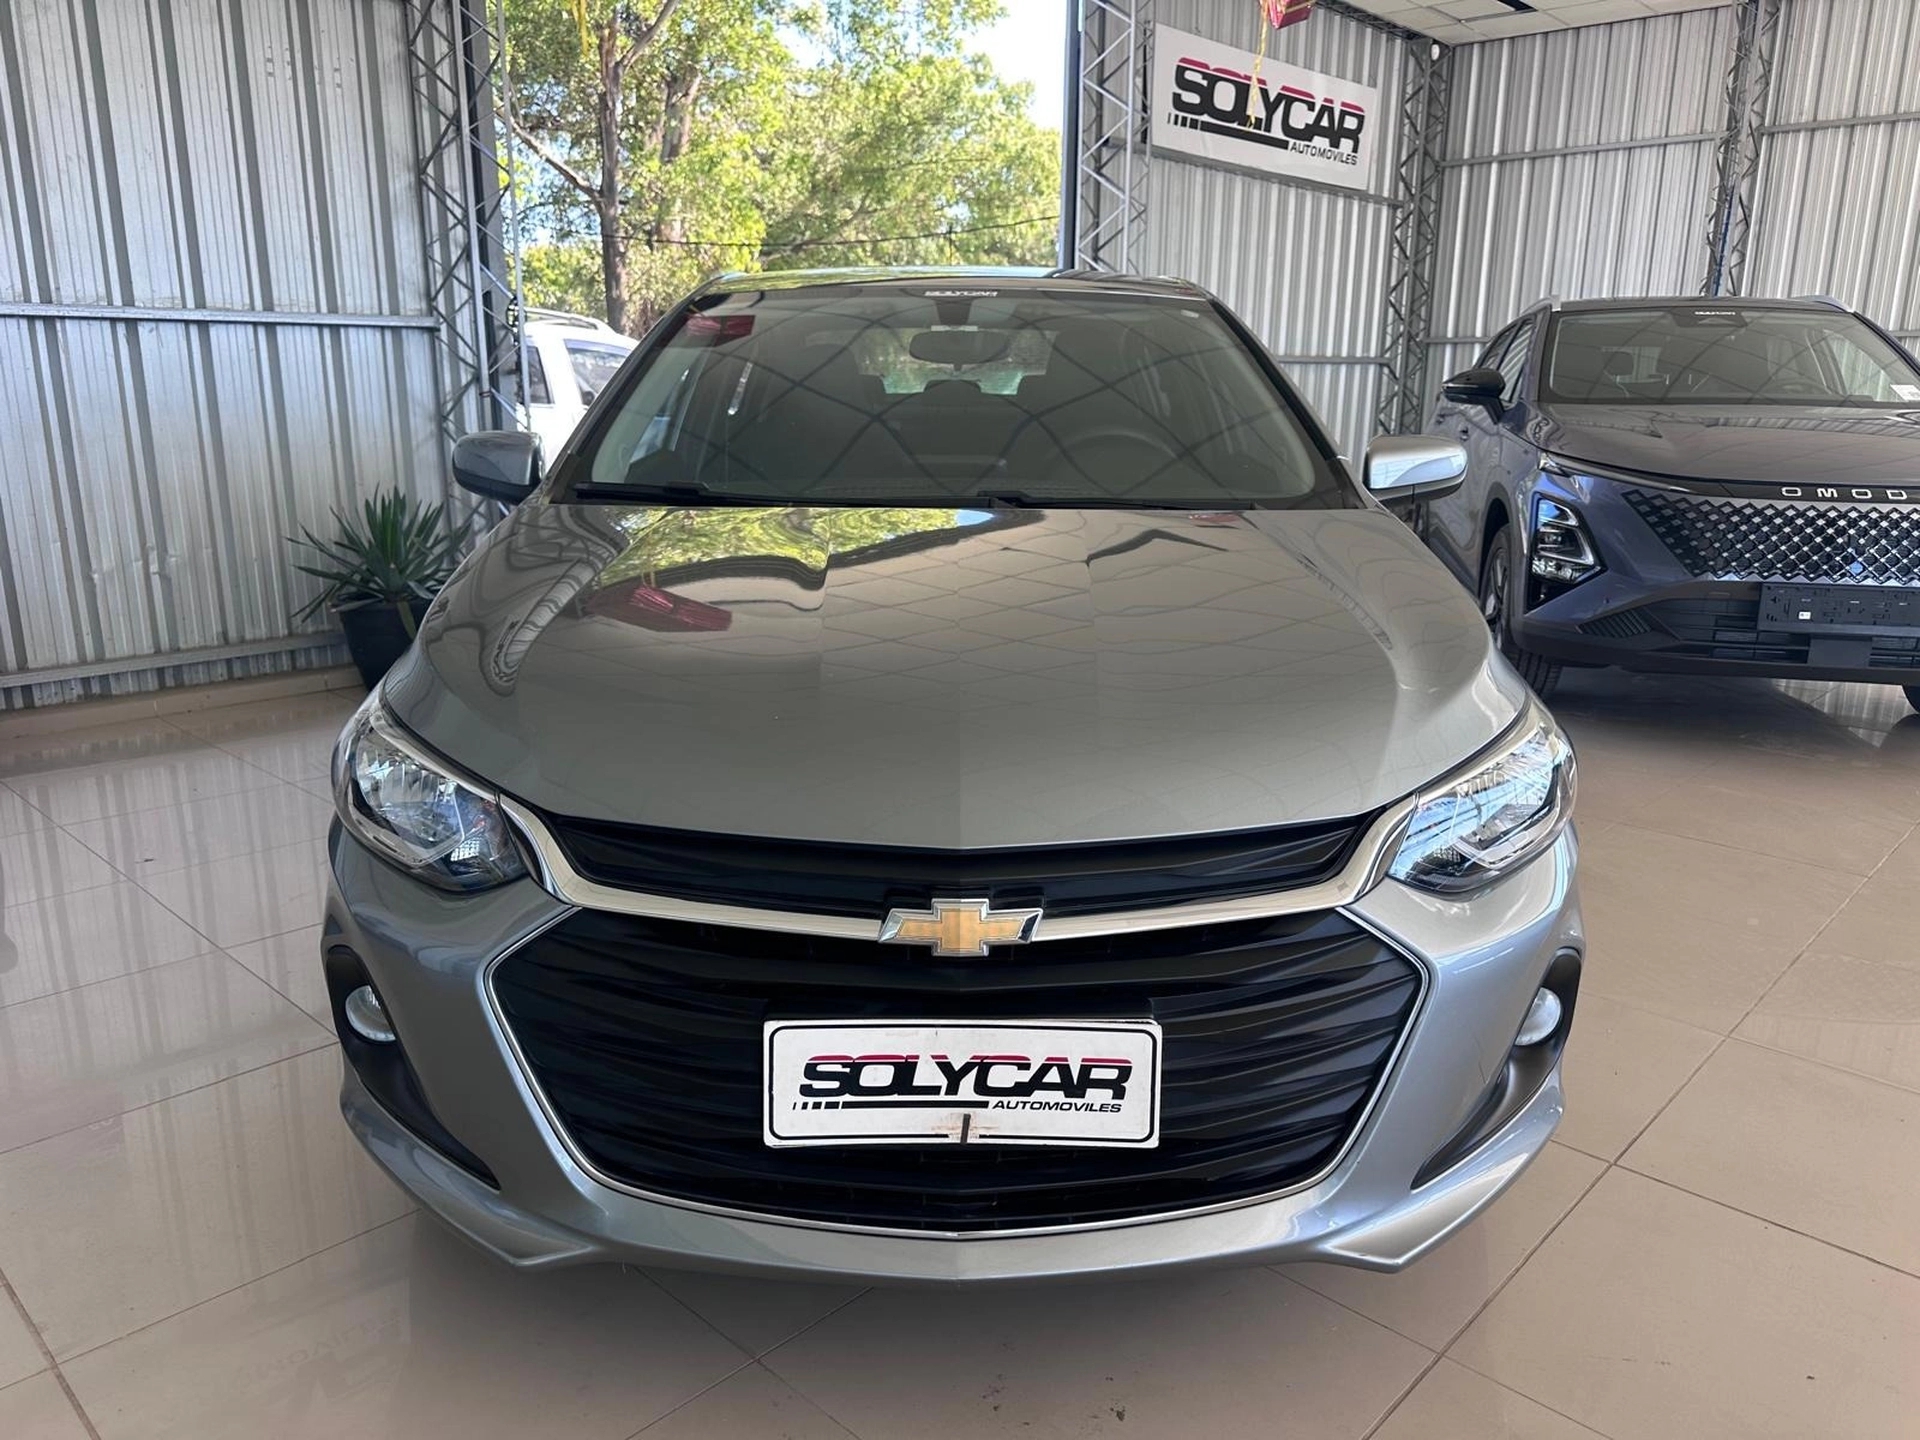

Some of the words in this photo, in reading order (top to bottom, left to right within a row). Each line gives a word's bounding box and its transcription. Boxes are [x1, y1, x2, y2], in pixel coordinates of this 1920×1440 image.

[1172, 57, 1365, 154] SOLYCAR
[1289, 141, 1358, 166] AUTOMOVILES
[799, 1054, 1133, 1100] SOLYCAR
[992, 1100, 1122, 1113] AUTOMOVILES
